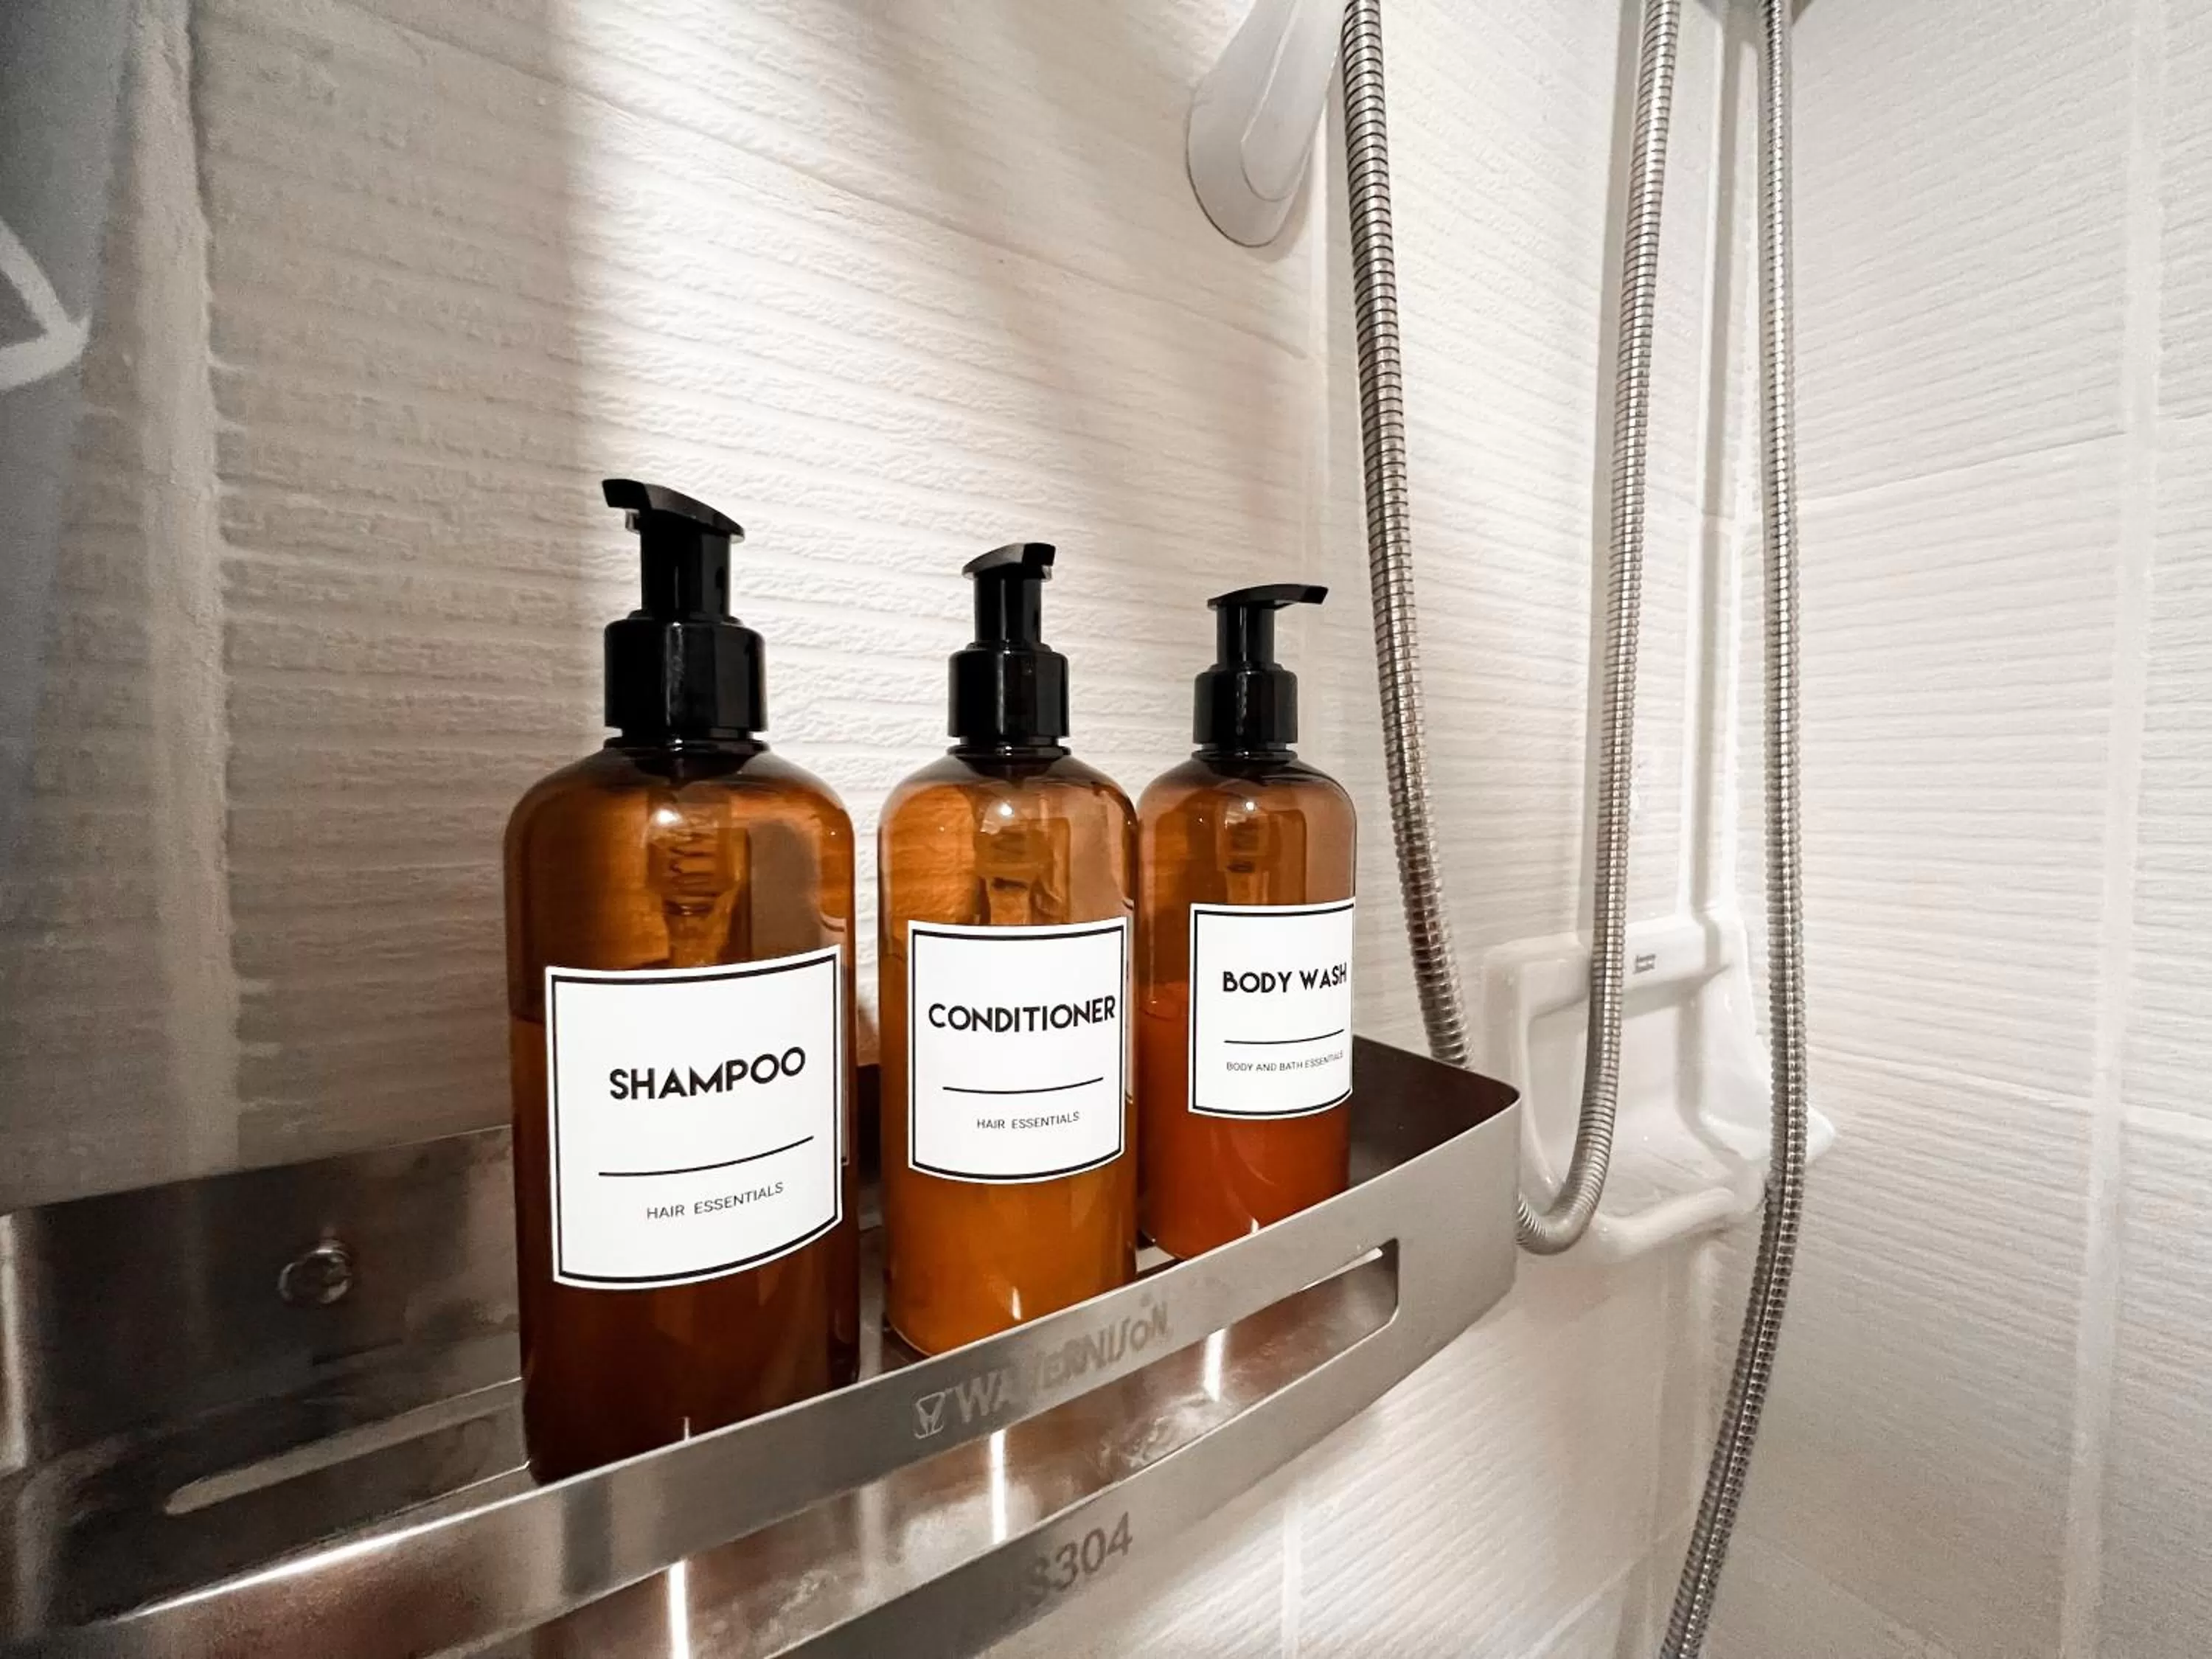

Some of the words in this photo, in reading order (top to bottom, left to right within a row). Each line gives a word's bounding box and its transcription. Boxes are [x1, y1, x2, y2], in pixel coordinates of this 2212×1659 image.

[1222, 970, 1293, 993] BODY
[1298, 961, 1347, 990] WASH
[928, 995, 1116, 1032] CONDITIONER
[610, 1047, 805, 1100] SHAMPOO
[1226, 1061, 1253, 1071] BODY
[1255, 1062, 1277, 1071] AND
[1279, 1061, 1303, 1071] BATH
[1304, 1049, 1343, 1068] ESSENTIALS
[976, 1119, 1006, 1129] HAIR
[1011, 1111, 1079, 1130] ESSENTIALS
[647, 1204, 685, 1219] HAIR
[694, 1181, 784, 1214] ESSENTIALS
